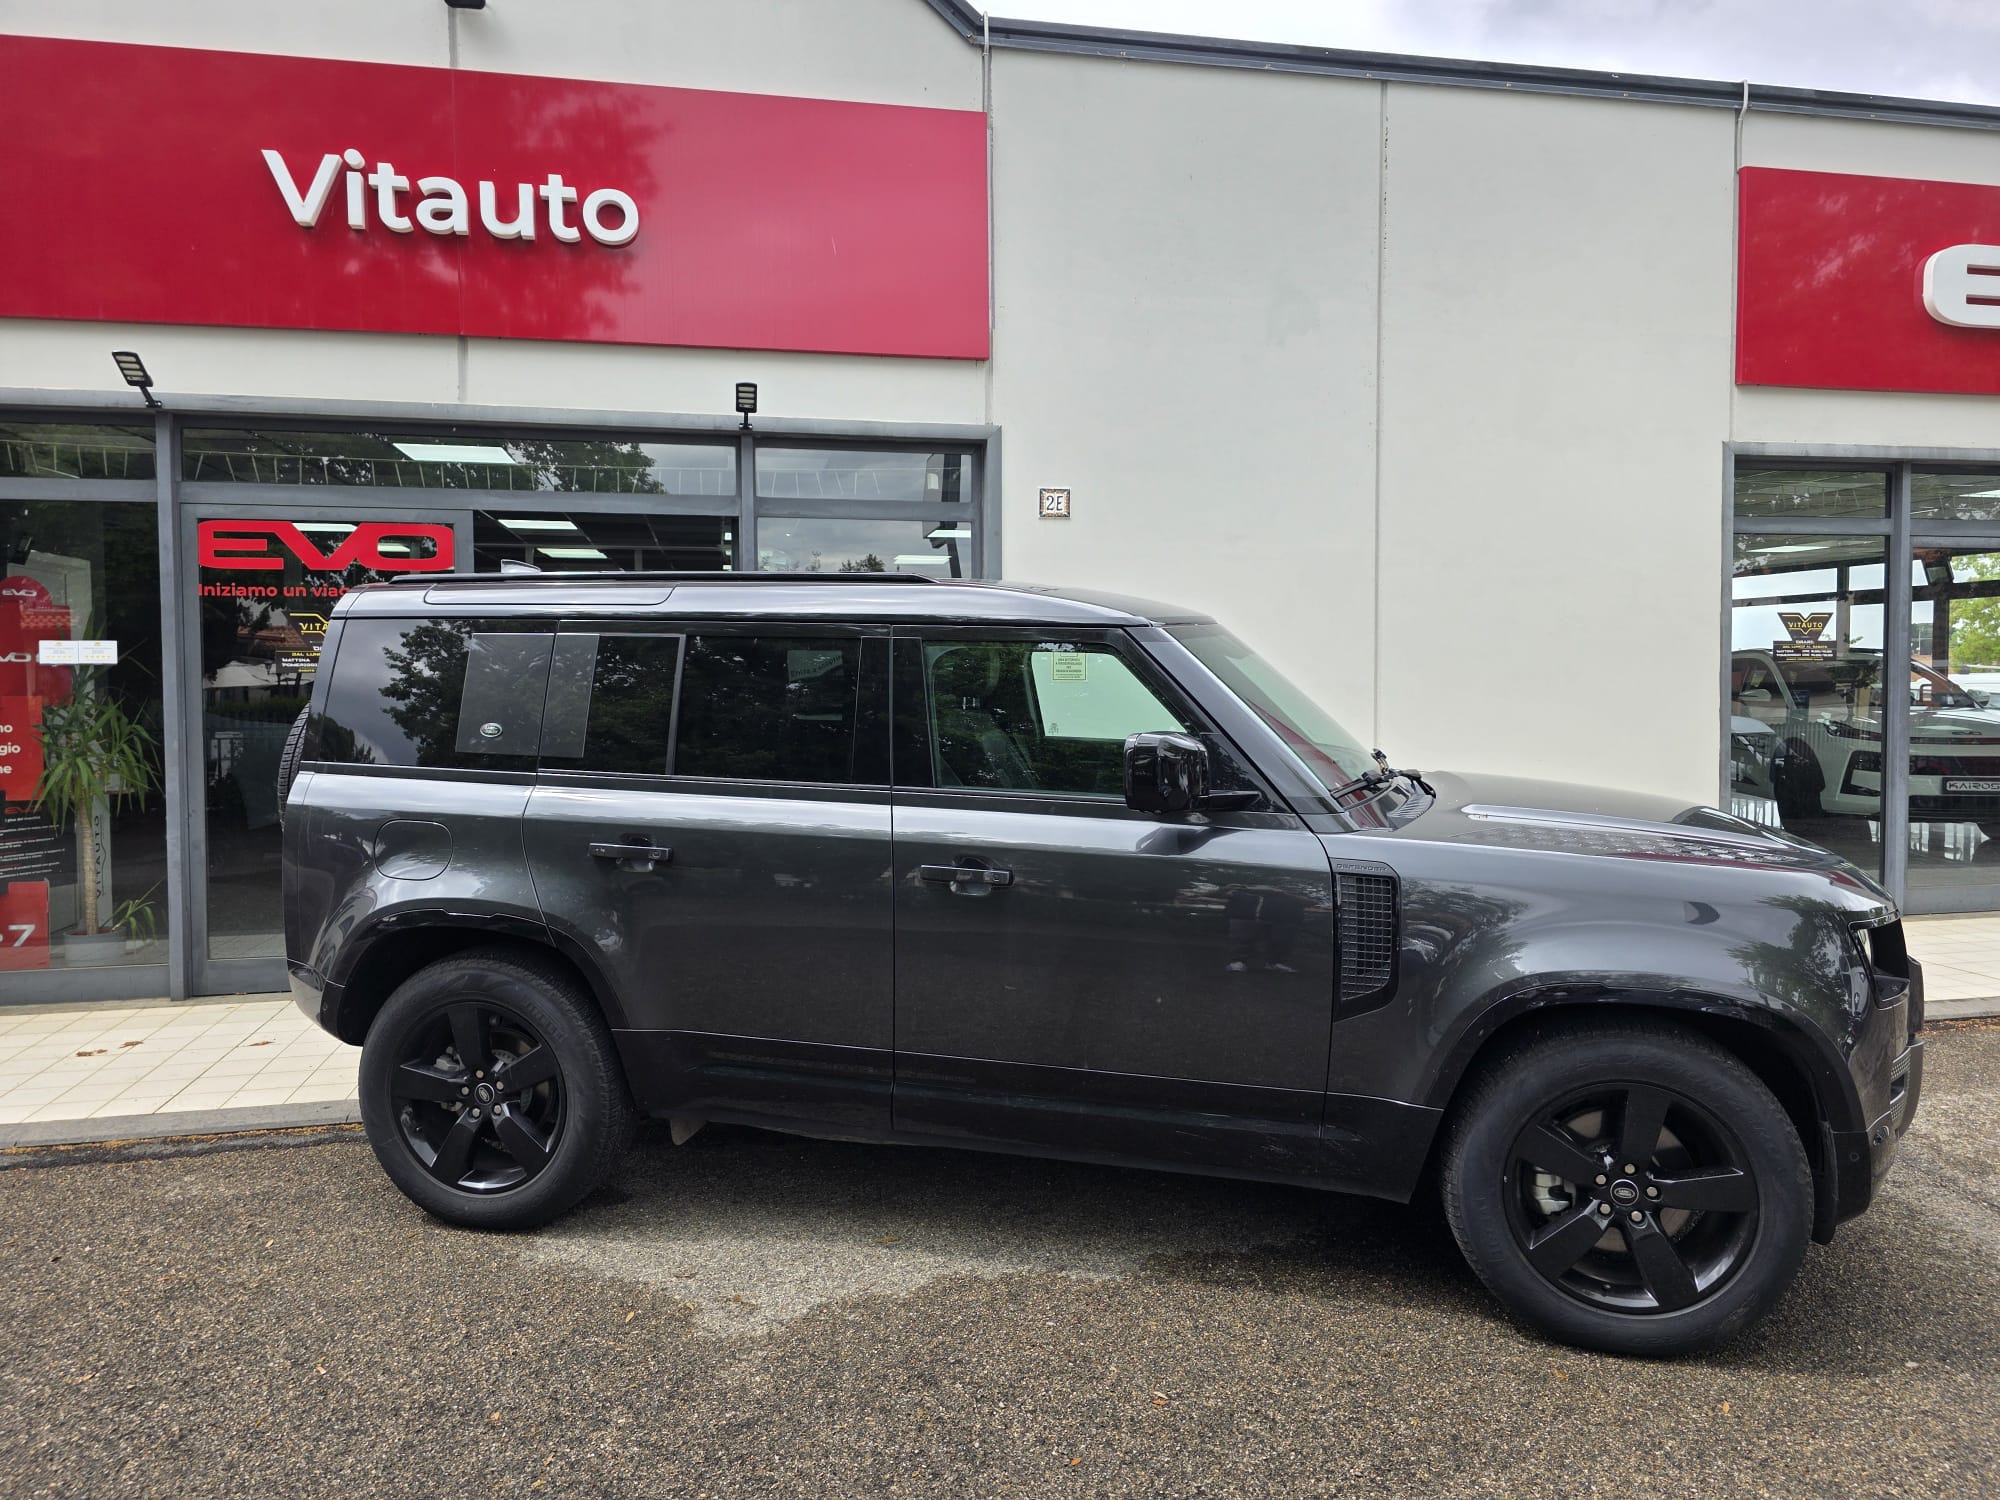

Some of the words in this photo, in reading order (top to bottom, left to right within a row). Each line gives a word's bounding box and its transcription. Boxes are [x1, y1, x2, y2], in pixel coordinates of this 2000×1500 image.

[261, 148, 640, 246] Vitauto
[1046, 495, 1064, 511] 2E
[198, 520, 454, 571] EVO
[2, 588, 37, 597] EVO
[198, 582, 278, 598] Iniziamo
[283, 585, 307, 598] un
[1948, 782, 2000, 790] KAIROS
[8, 923, 36, 947] 7
